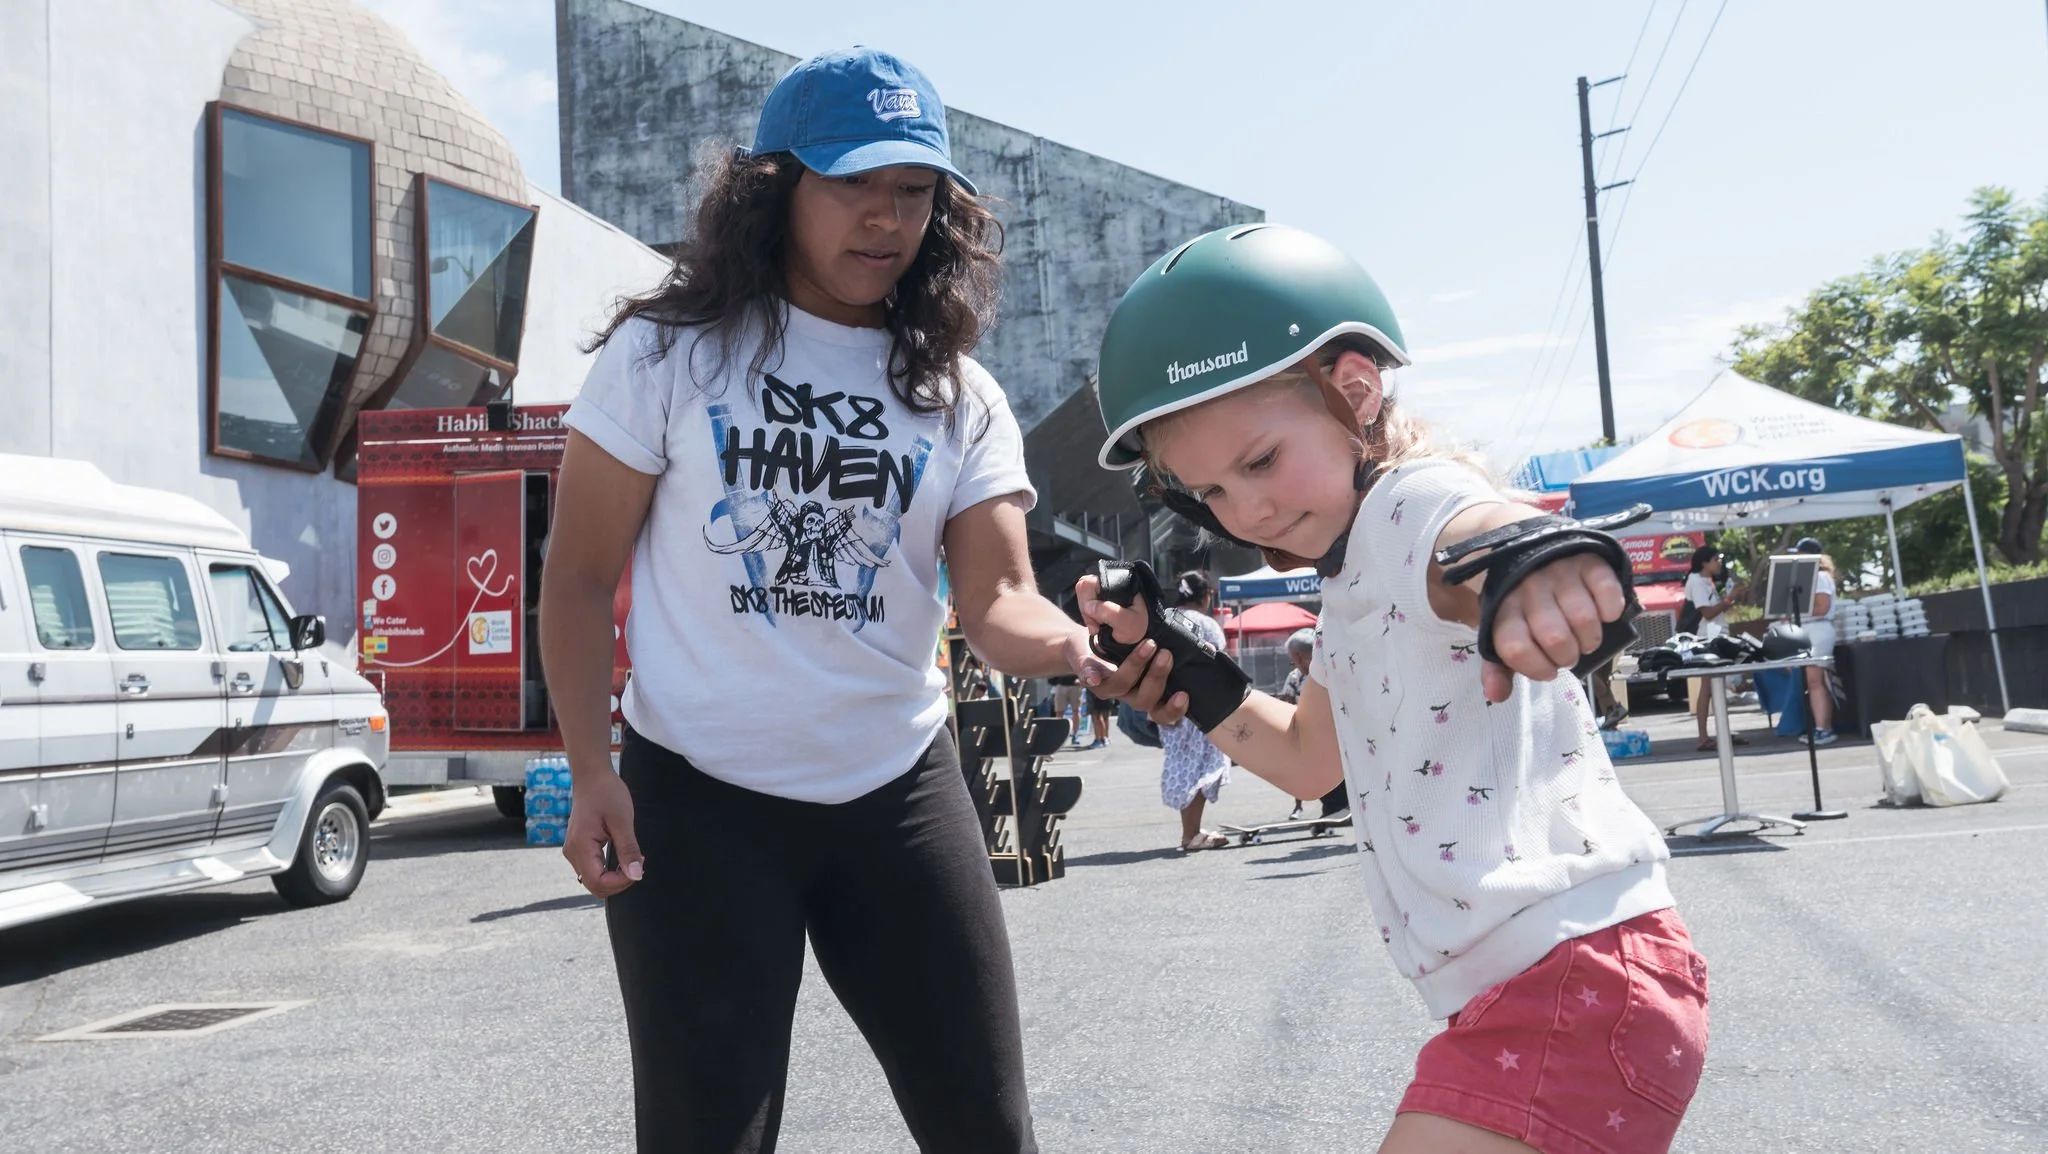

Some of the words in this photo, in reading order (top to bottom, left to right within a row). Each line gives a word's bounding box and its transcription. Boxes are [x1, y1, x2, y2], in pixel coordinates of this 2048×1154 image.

[867, 88, 921, 121] Vans
[1166, 340, 1249, 384] thousand
[437, 413, 490, 432] Habi
[762, 374, 889, 440] SK8
[538, 441, 564, 451] Fusion
[721, 426, 914, 513] HAVEN
[1702, 467, 1826, 498] WCK.org
[730, 584, 769, 614] SK8
[770, 587, 811, 616] THE
[372, 617, 385, 625] We
[386, 616, 407, 625] Cater
